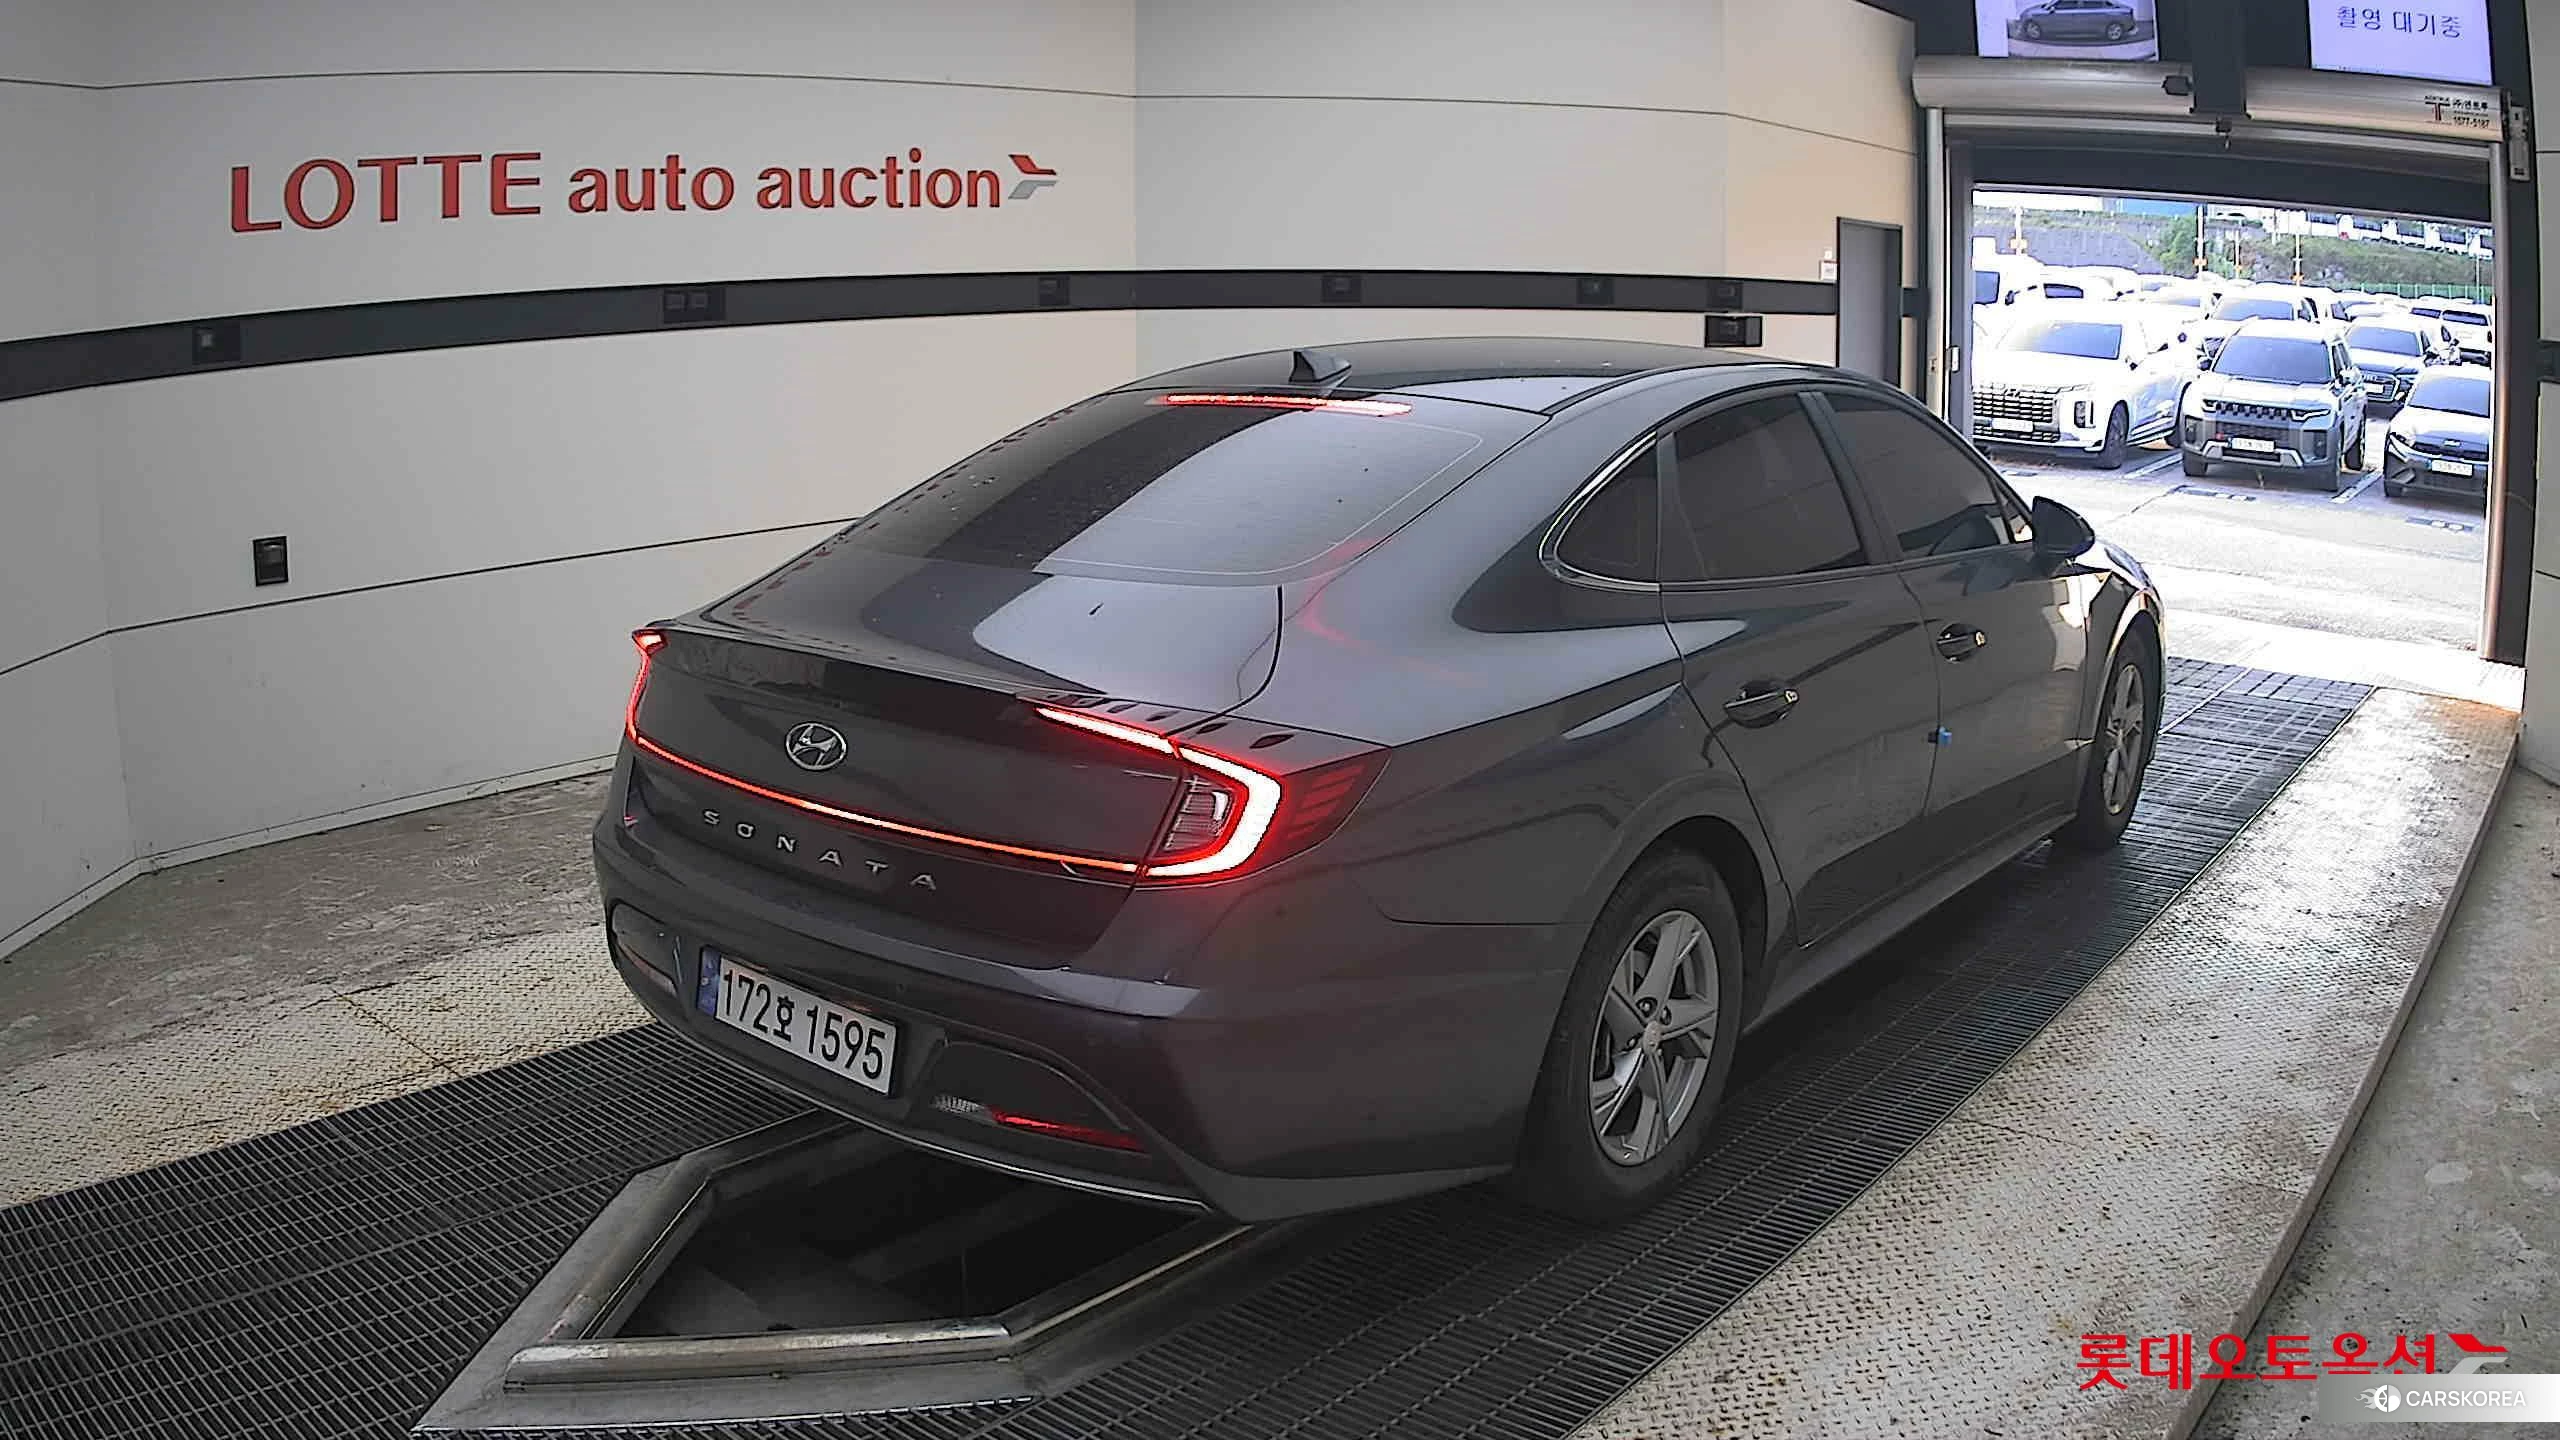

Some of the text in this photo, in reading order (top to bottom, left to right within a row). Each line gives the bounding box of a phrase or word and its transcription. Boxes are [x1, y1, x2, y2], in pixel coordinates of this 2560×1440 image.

[2337, 6, 2464, 38] 촬영 대기중
[231, 148, 1001, 232] LOTTE auto auction
[703, 810, 937, 891] SONATA
[724, 969, 886, 1080] 172호 1595
